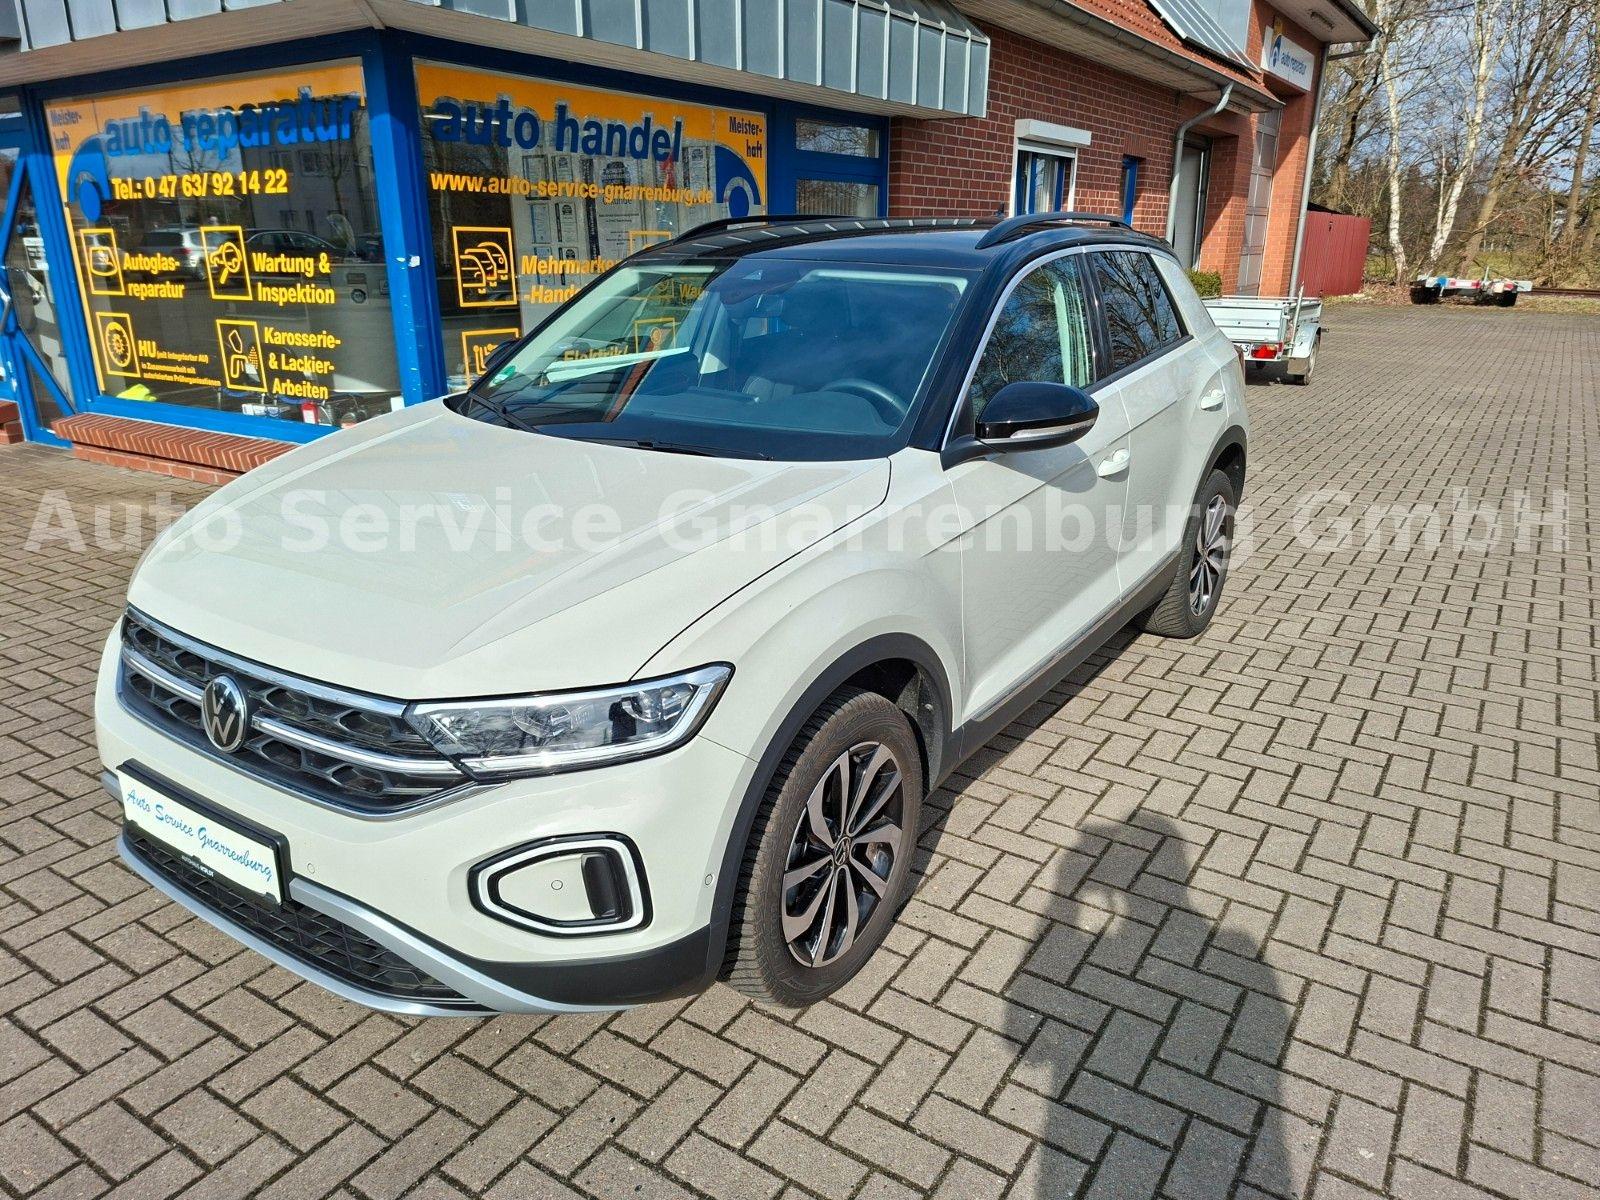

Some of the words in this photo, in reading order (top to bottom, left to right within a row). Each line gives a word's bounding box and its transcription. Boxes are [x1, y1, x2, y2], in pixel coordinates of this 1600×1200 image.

[106, 106, 172, 157] auto
[181, 88, 360, 161] reparatur
[431, 96, 540, 149] auto
[555, 103, 682, 162] handel
[729, 116, 762, 136] Meister-
[746, 139, 762, 158] haft
[112, 177, 142, 200] Tel.:
[145, 176, 155, 199] 0
[158, 175, 177, 198] 47
[182, 173, 208, 197] 63/
[212, 172, 234, 196] 92
[239, 171, 260, 195] 14
[265, 169, 288, 194] 22
[430, 172, 714, 206] www.auto-service-gnarrenburg.de
[123, 252, 180, 275] Autoglas-
[252, 252, 314, 278] Wartung
[318, 252, 331, 274] &
[521, 255, 618, 275] Mehrmarke
[128, 281, 185, 301] reparatur
[257, 281, 335, 307] Inspektion
[138, 340, 156, 358] HU
[264, 326, 341, 349] Karosserie-
[269, 352, 279, 369] &
[281, 355, 335, 375] Lackier-
[272, 377, 329, 400] Arbeiten
[127, 789, 151, 813] Auto
[155, 804, 194, 837] Service
[197, 826, 273, 882] Gnarrenburg
